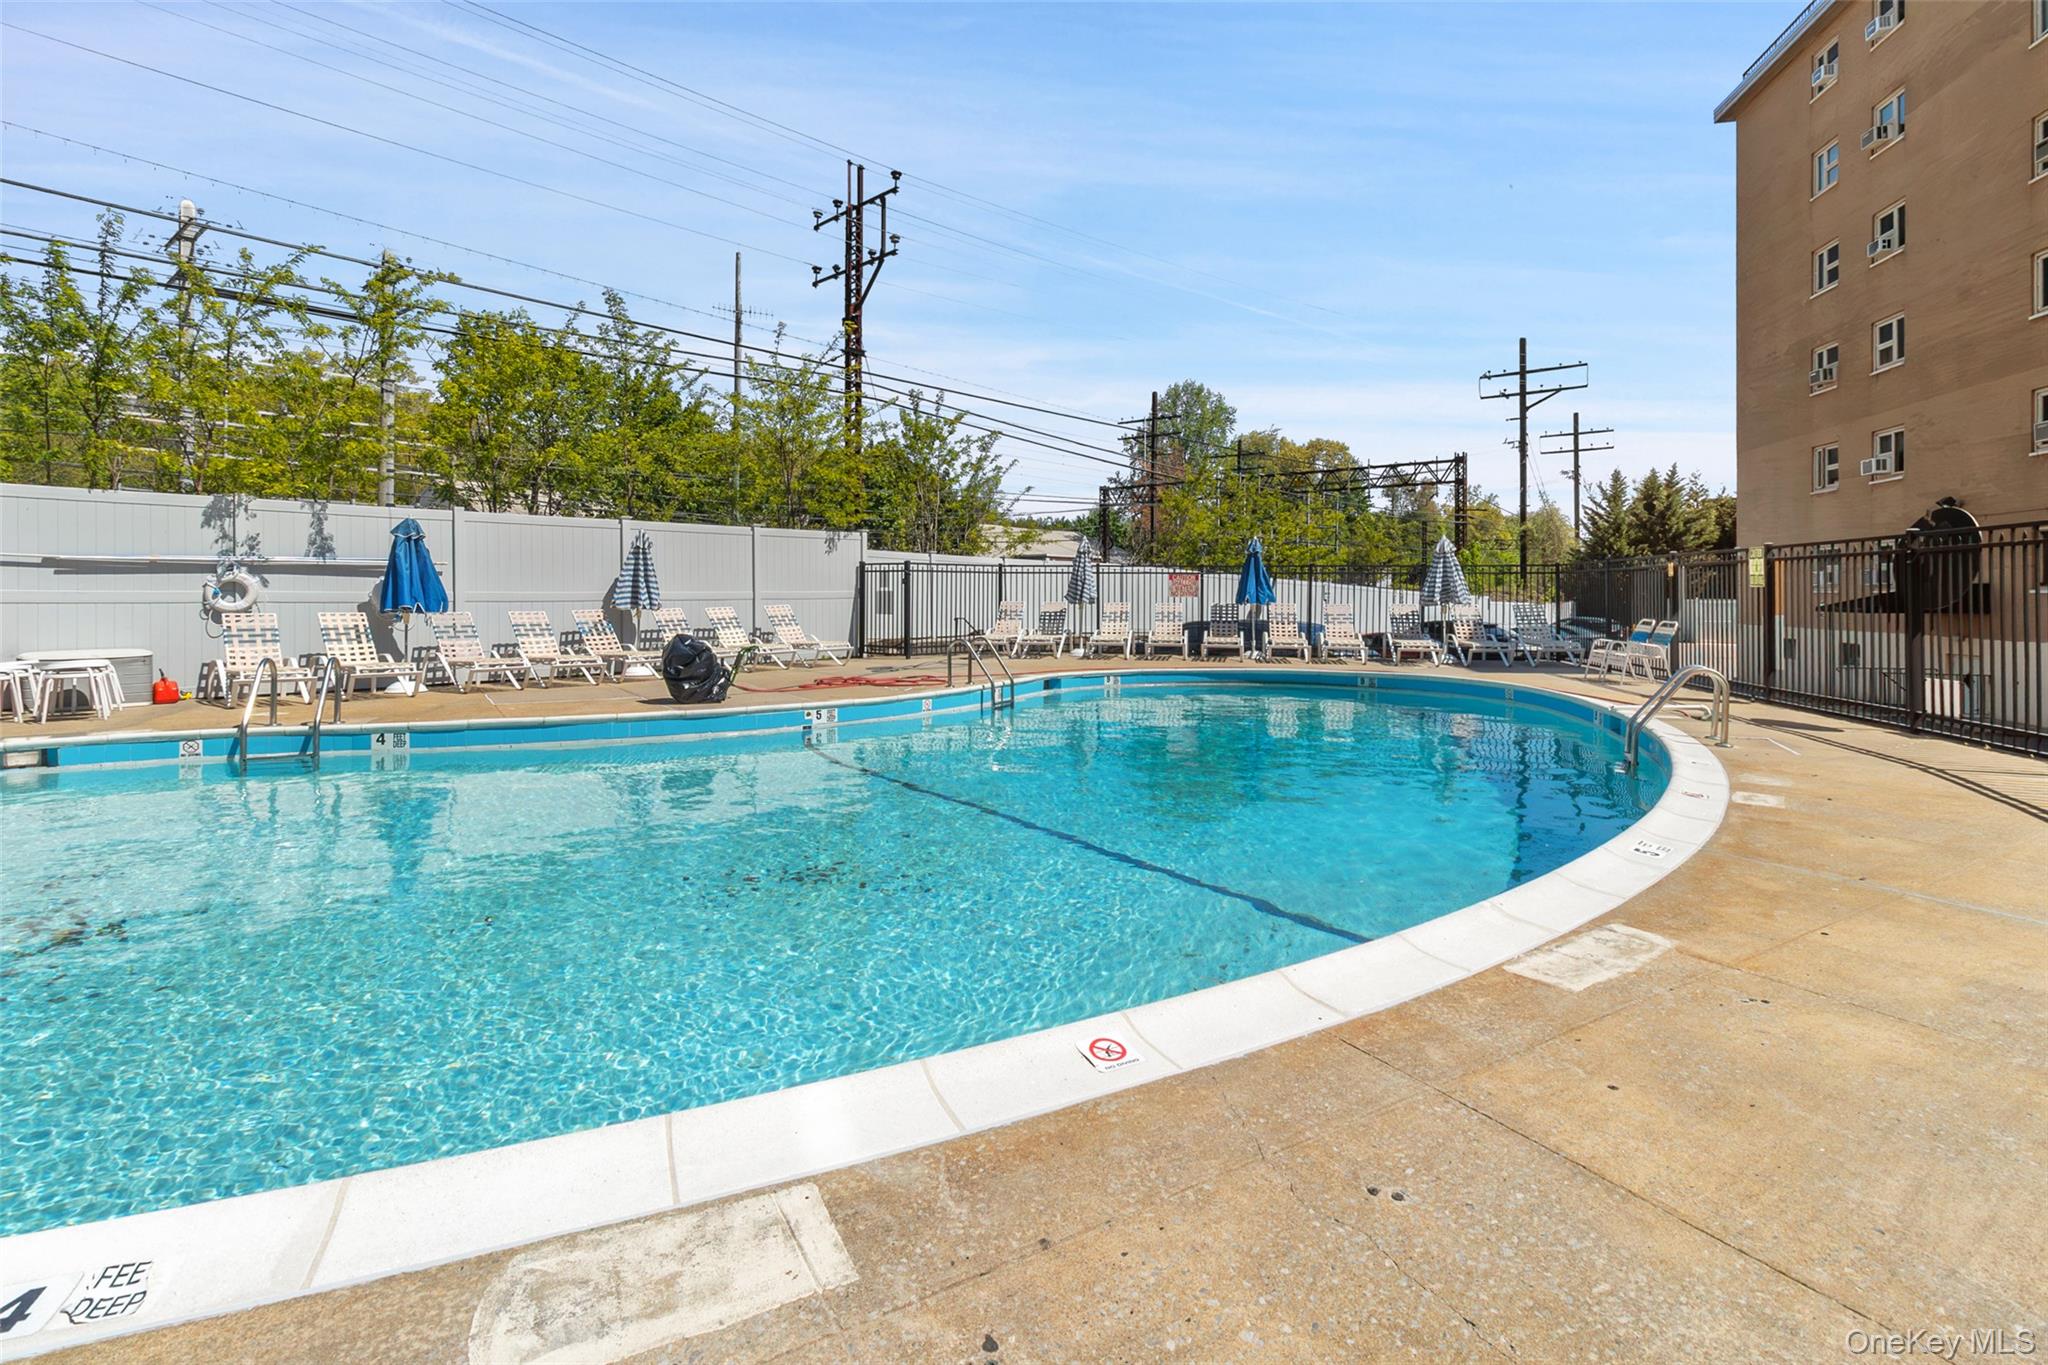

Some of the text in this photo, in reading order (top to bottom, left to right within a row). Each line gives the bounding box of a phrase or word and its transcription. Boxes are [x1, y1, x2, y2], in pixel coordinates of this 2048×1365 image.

[816, 710, 822, 720] 5
[376, 733, 386, 745] 4
[0, 1286, 47, 1333] 4
[72, 1290, 147, 1319] DEEP
